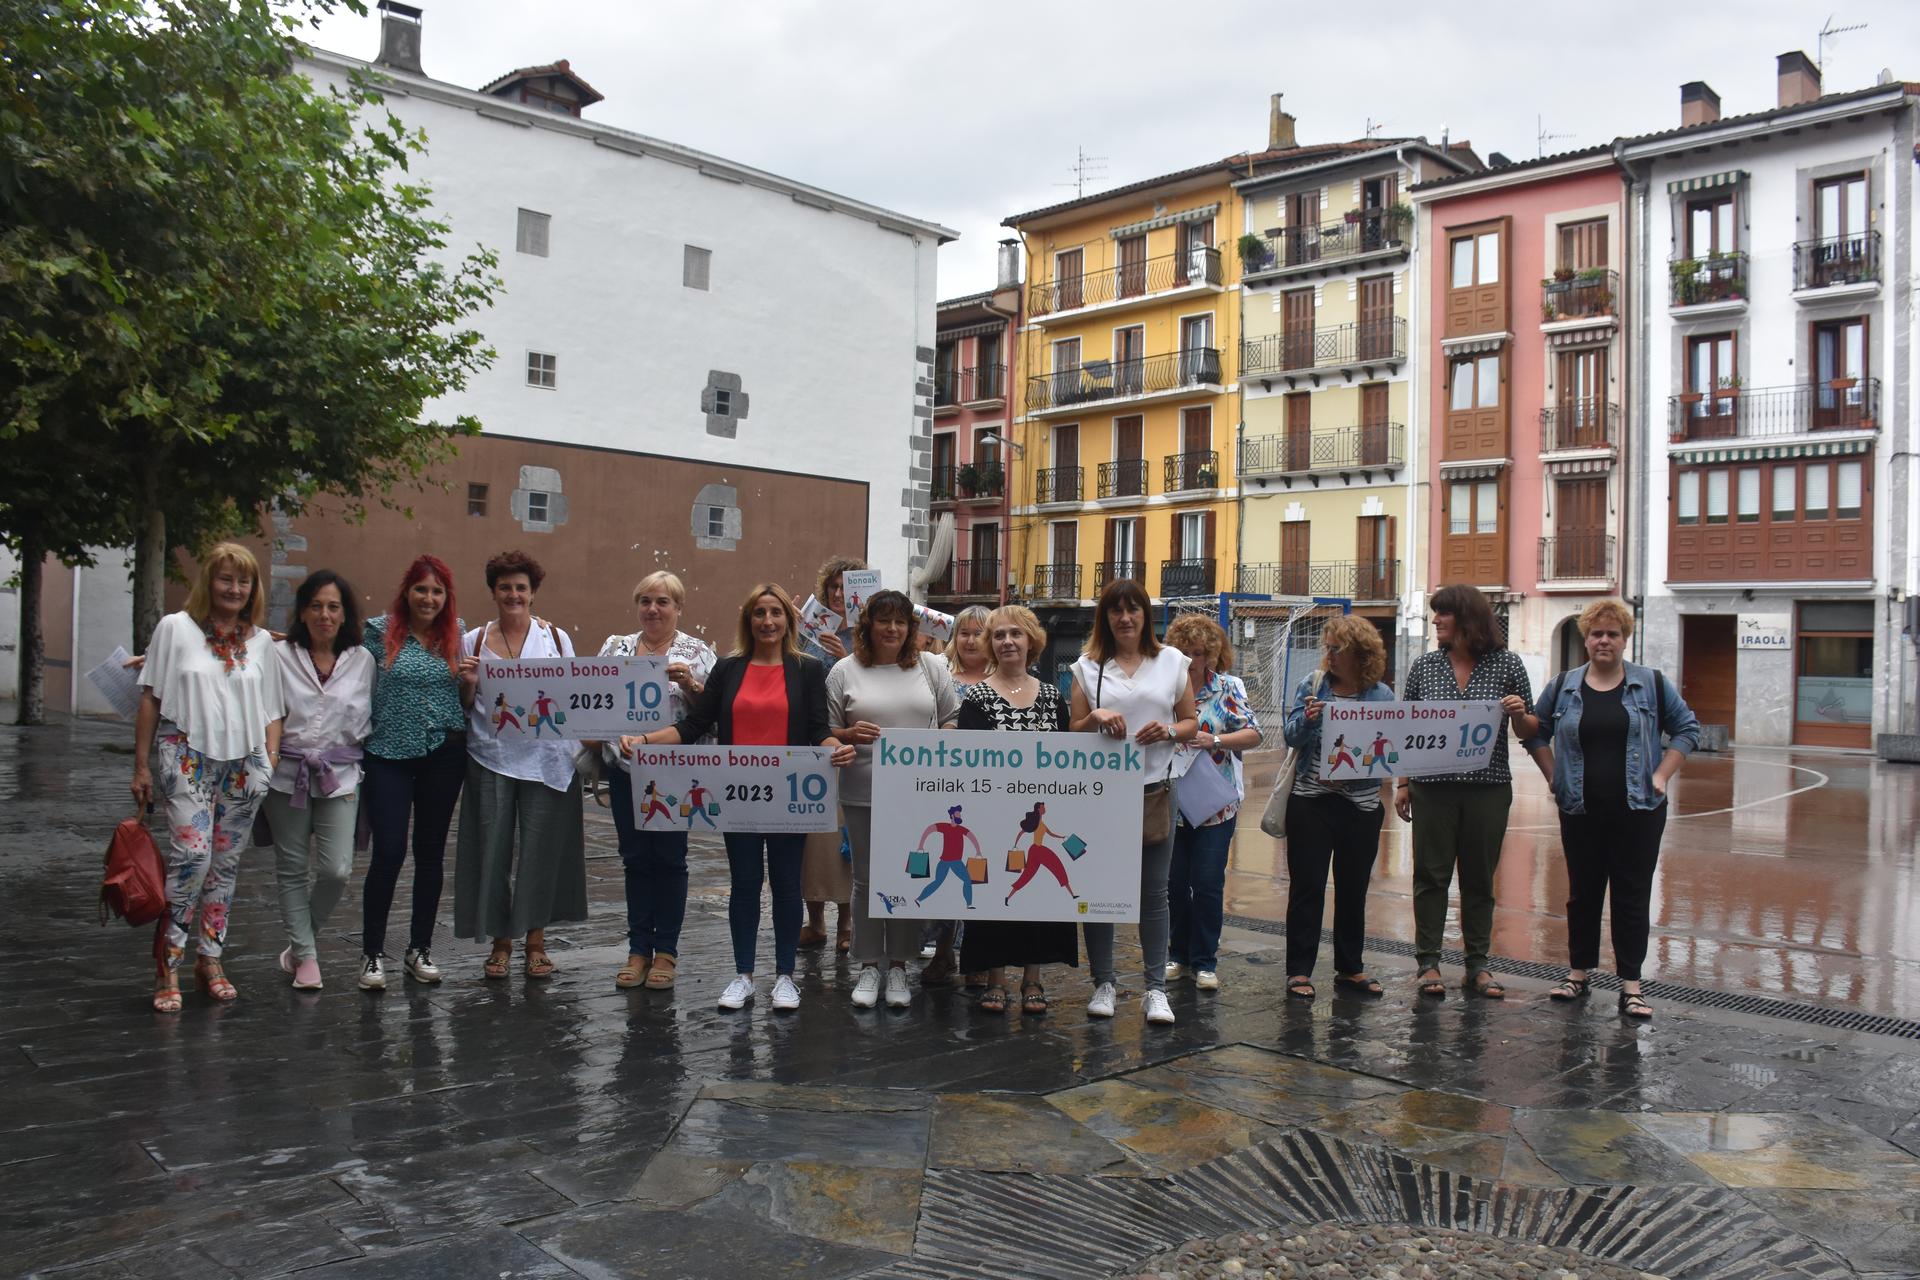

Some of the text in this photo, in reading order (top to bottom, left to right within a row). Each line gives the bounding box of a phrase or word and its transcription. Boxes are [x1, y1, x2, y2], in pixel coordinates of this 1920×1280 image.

[1741, 635, 1786, 645] IRAOLA
[486, 661, 619, 679] kontsumo bonoa
[570, 692, 614, 710] 2023
[624, 680, 662, 710] 10
[626, 708, 660, 722] euro
[1330, 704, 1456, 721] kontsumo bonoa
[1404, 734, 1447, 750] 2023
[1459, 722, 1492, 748] 10
[637, 749, 780, 768] kontsumo bonoa
[880, 737, 1142, 771] kontsumo bonoak
[1456, 746, 1487, 758] euro
[725, 784, 774, 802] 2023
[786, 772, 828, 802] 10
[916, 777, 965, 793] irailak
[971, 778, 992, 793] 15
[1006, 780, 1088, 796] abenduak
[1092, 781, 1104, 796] 9
[788, 802, 826, 814] euro
